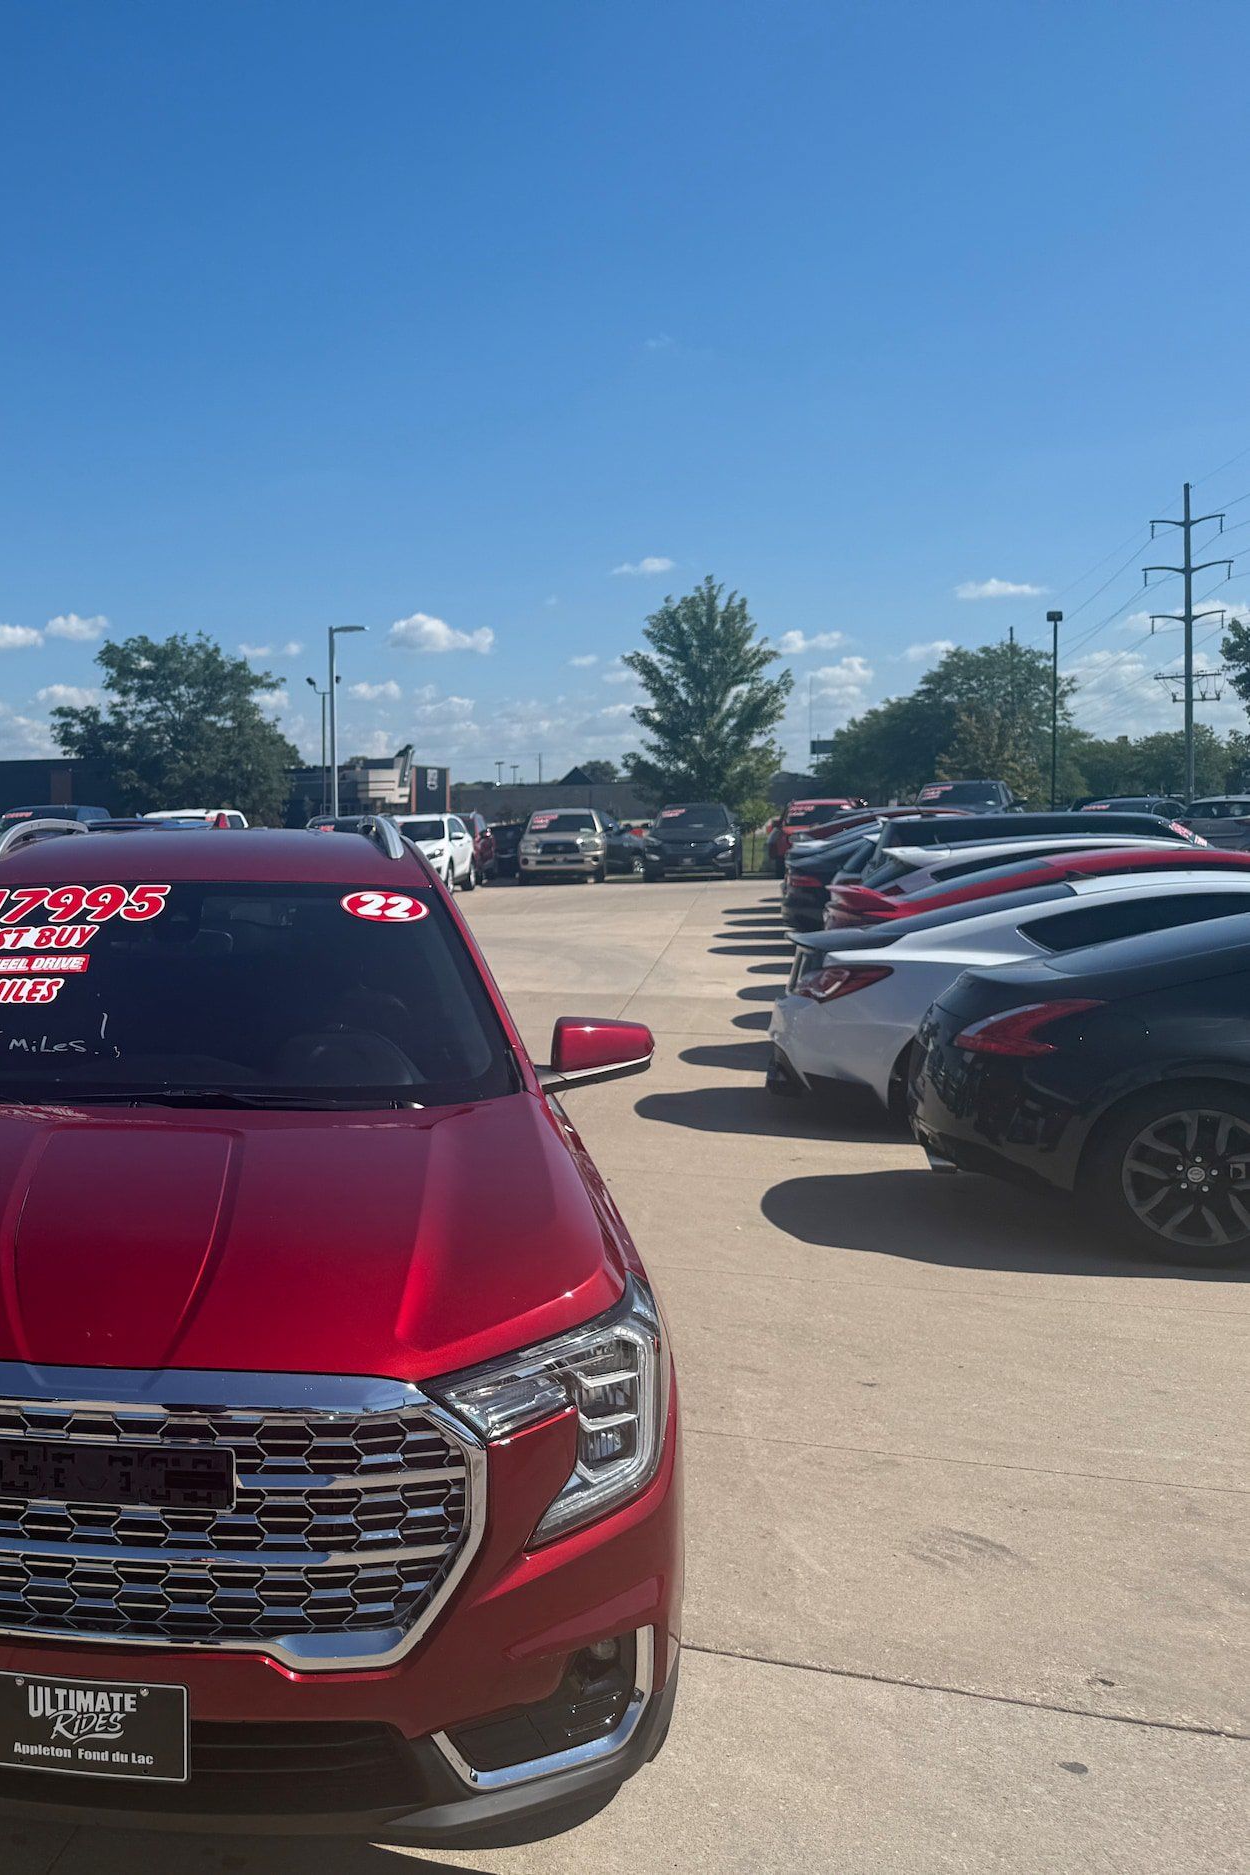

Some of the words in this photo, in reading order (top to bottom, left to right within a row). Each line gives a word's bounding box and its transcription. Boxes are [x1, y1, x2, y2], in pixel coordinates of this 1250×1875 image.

[356, 894, 414, 918] 22
[34, 924, 99, 949] BUY
[31, 956, 85, 971] DRIVE
[28, 1685, 138, 1718] ULTIMATE
[13, 1742, 72, 1759] Appleton
[77, 1748, 109, 1762] Fond
[111, 1751, 129, 1763] du
[131, 1752, 154, 1765] Lac
